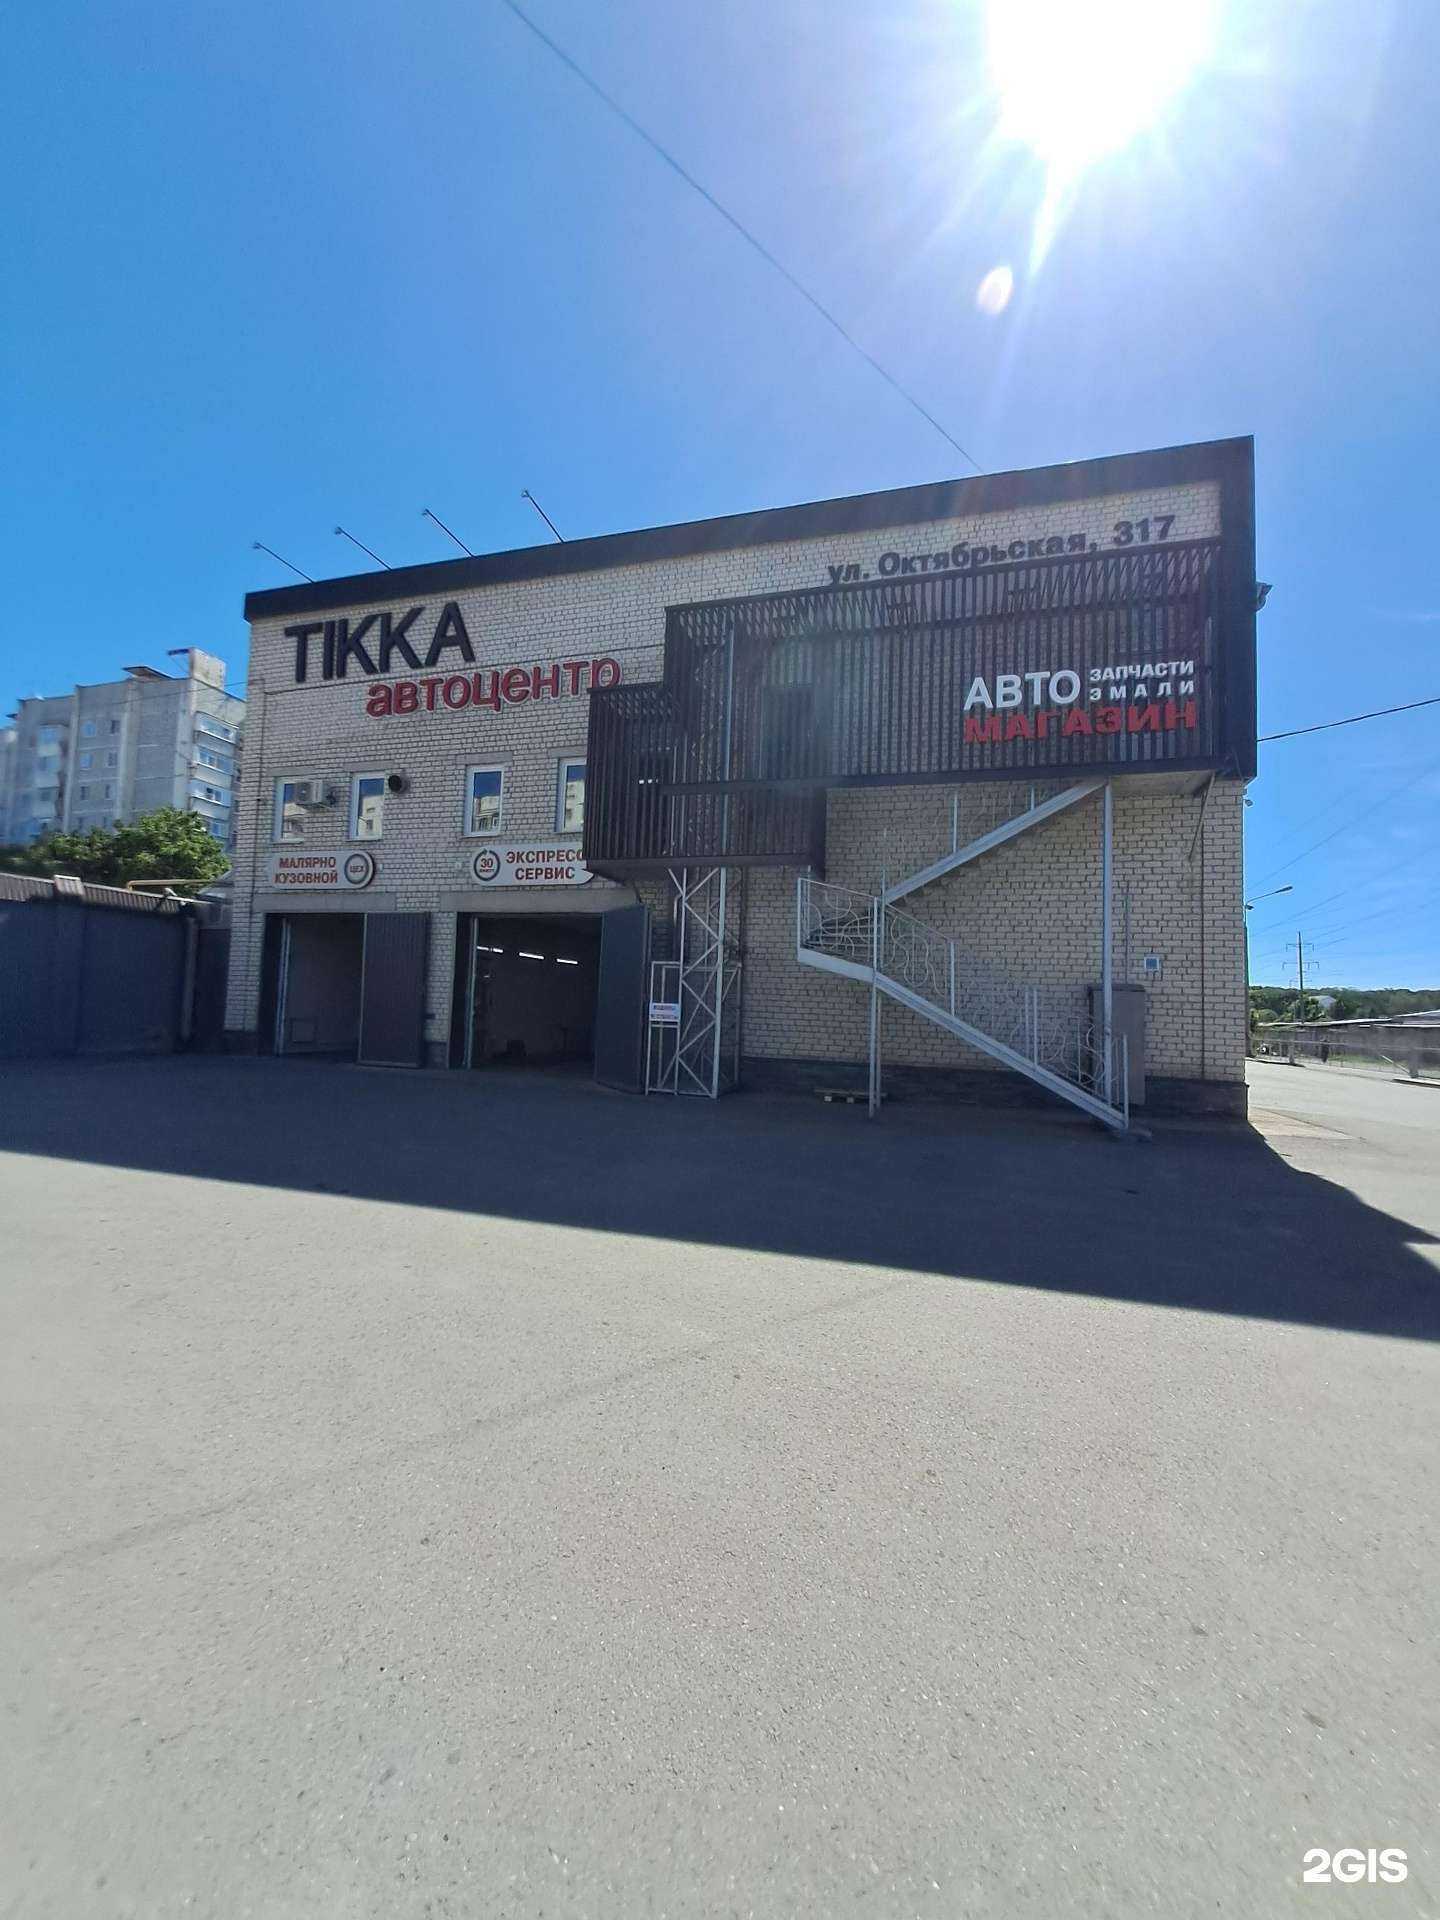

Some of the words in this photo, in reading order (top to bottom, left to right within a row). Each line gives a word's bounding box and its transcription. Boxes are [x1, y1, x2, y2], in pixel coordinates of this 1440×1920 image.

[828, 561, 870, 586] ул.
[878, 533, 1097, 576] Октябрьская,
[1113, 515, 1176, 546] 317
[285, 601, 476, 683] TIKKA
[1090, 660, 1194, 681] ЗАПЧАСТИ
[964, 670, 1081, 710] АВТО
[963, 700, 1197, 744] МАГАЗИН
[278, 856, 337, 869] МАЛЯРНО
[480, 858, 494, 869] 30
[274, 871, 338, 884] КУЗОВНОЙ
[515, 867, 576, 881] СЕРВИС
